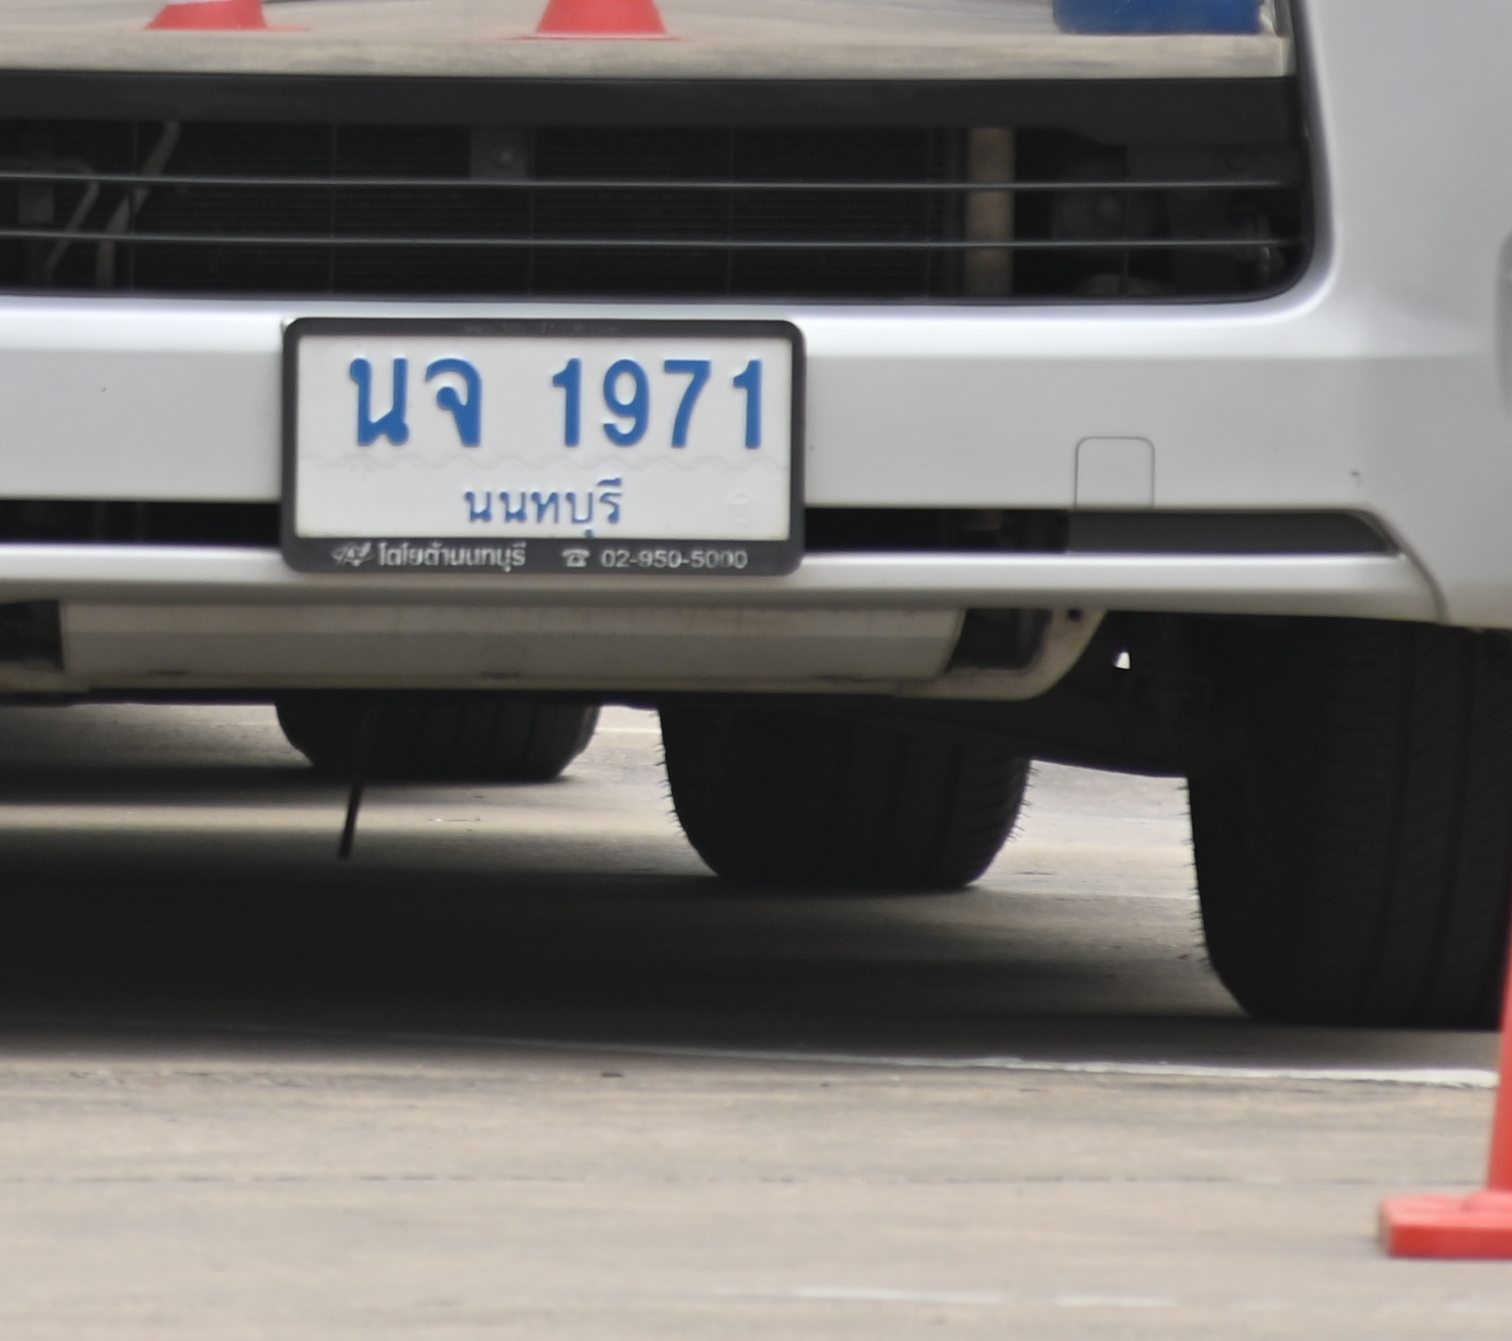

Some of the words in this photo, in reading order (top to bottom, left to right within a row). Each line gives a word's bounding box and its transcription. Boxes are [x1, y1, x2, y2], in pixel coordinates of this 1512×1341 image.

[350, 357, 483, 447] นจ
[551, 357, 764, 449] 1971
[464, 477, 623, 538] นนทบุรี
[601, 549, 749, 571] 02-950-5000
